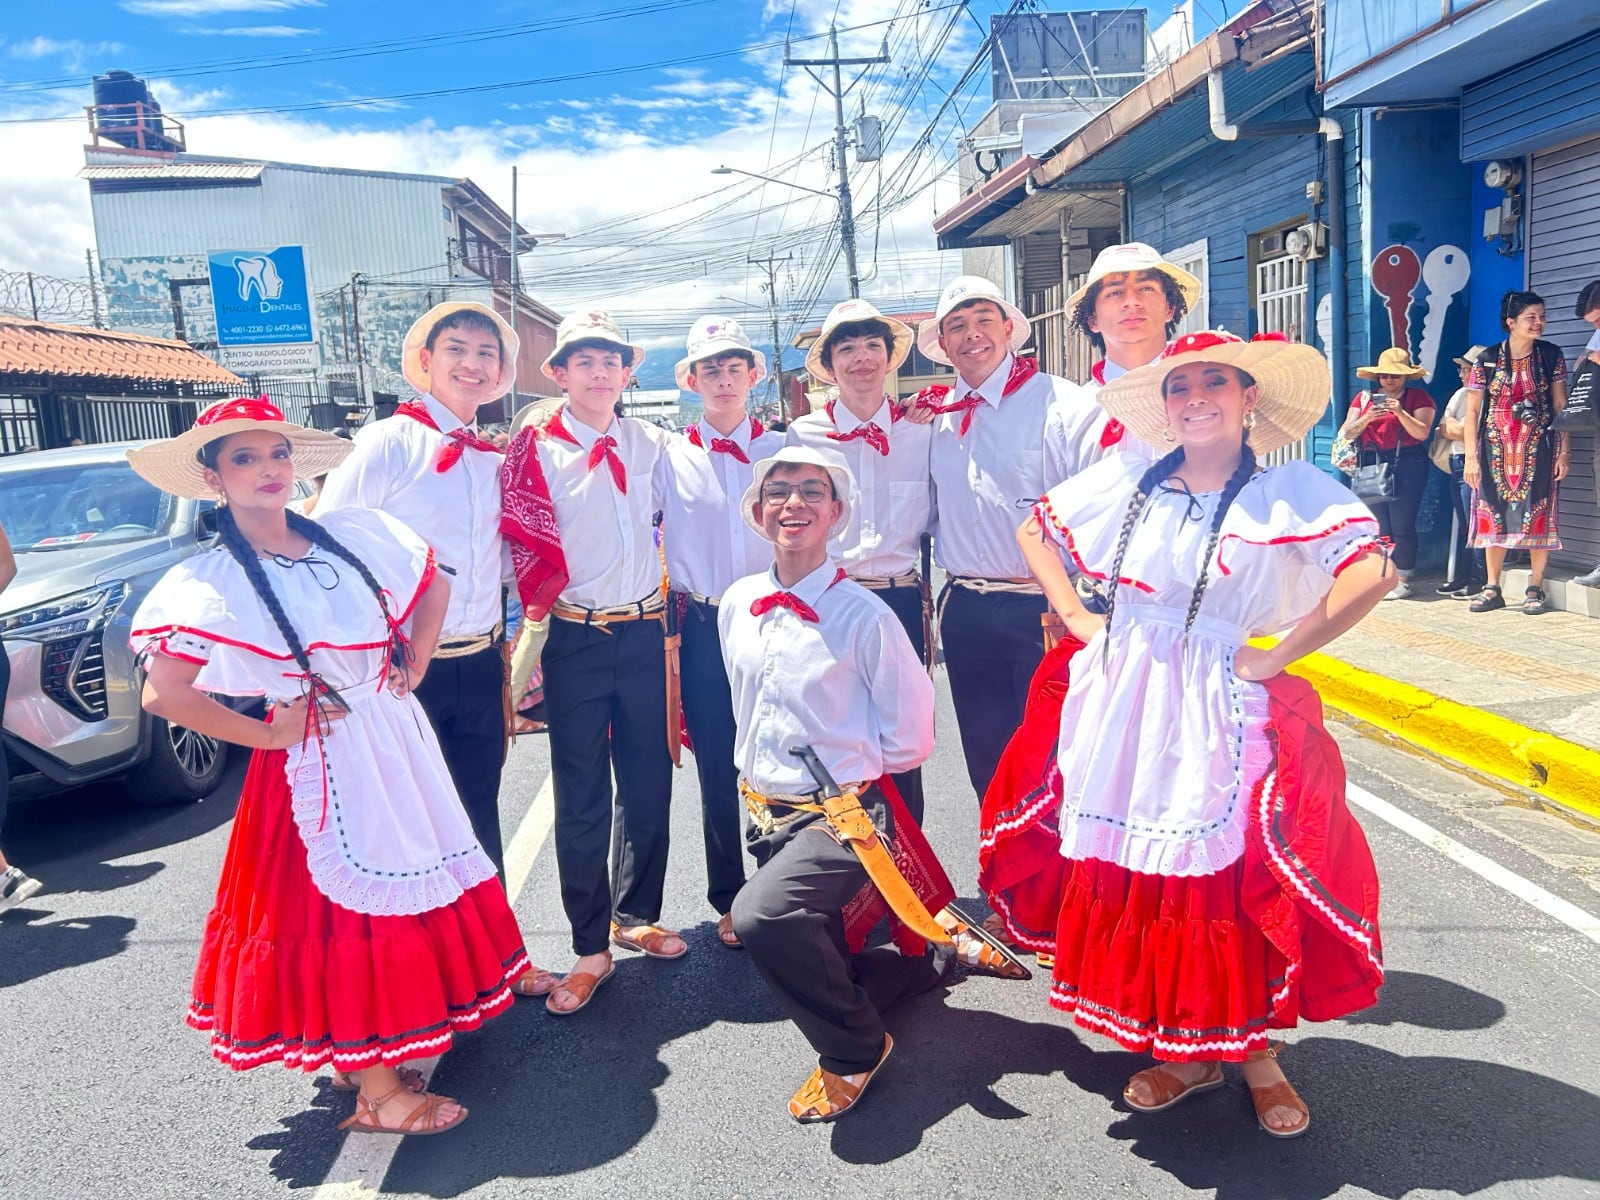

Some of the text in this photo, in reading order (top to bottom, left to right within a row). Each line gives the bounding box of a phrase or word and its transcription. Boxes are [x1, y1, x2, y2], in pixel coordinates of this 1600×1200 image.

[260, 301, 302, 313] DENTALES
[231, 325, 263, 334] 4001-2230
[223, 347, 313, 359] CENTRO RADIOLÓGICO Y
[227, 358, 312, 368] TOMOGRÁFICO DENTAL
